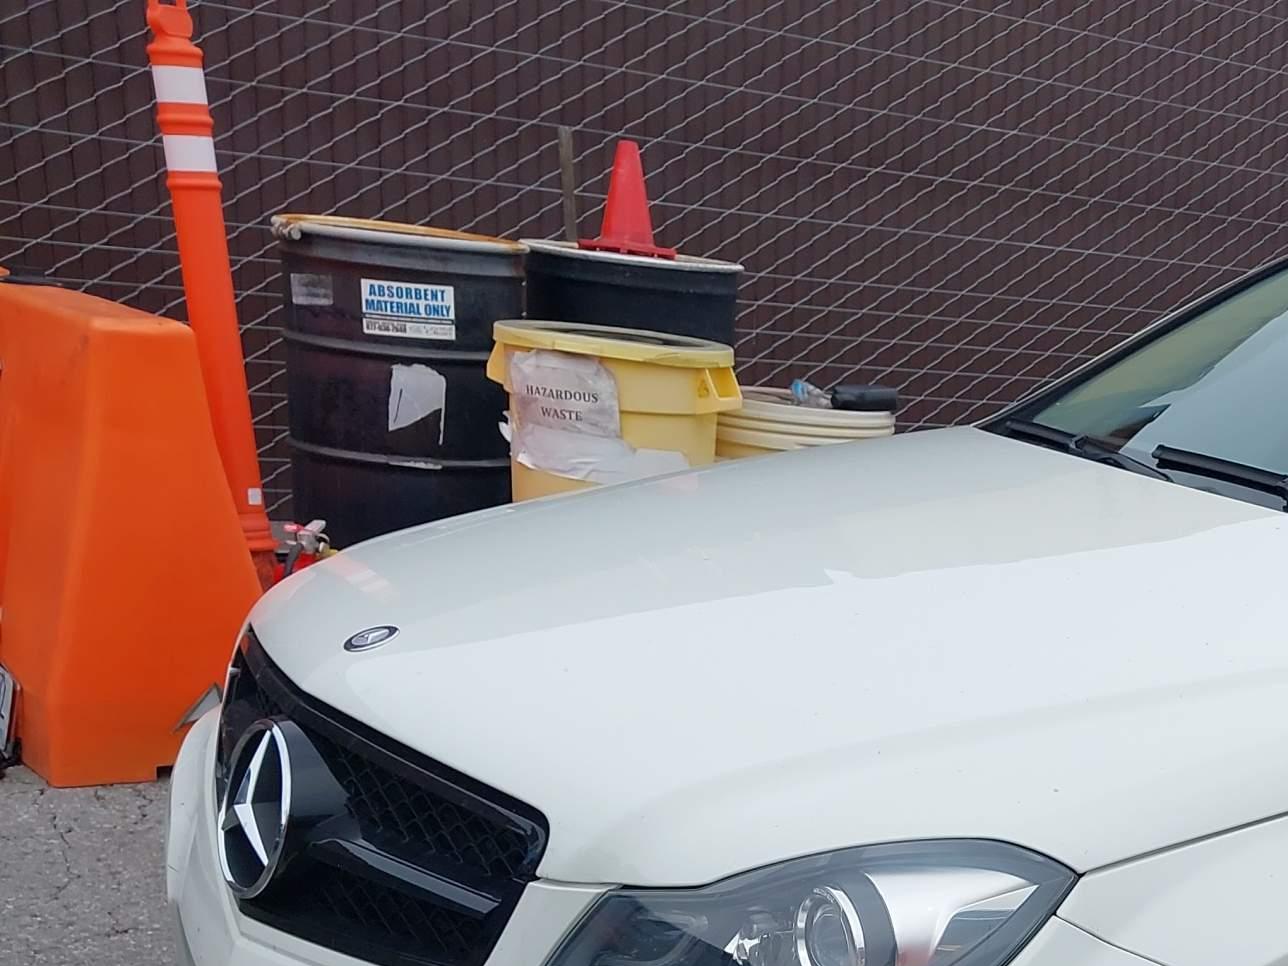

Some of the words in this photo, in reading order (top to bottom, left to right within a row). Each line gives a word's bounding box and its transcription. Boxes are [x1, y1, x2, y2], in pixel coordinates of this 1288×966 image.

[368, 283, 446, 302] ABSORBENT
[365, 298, 422, 316] MATERIAL
[424, 302, 451, 318] ONLY
[525, 384, 600, 404] HAZARDOUS
[540, 406, 583, 422] WASTE
